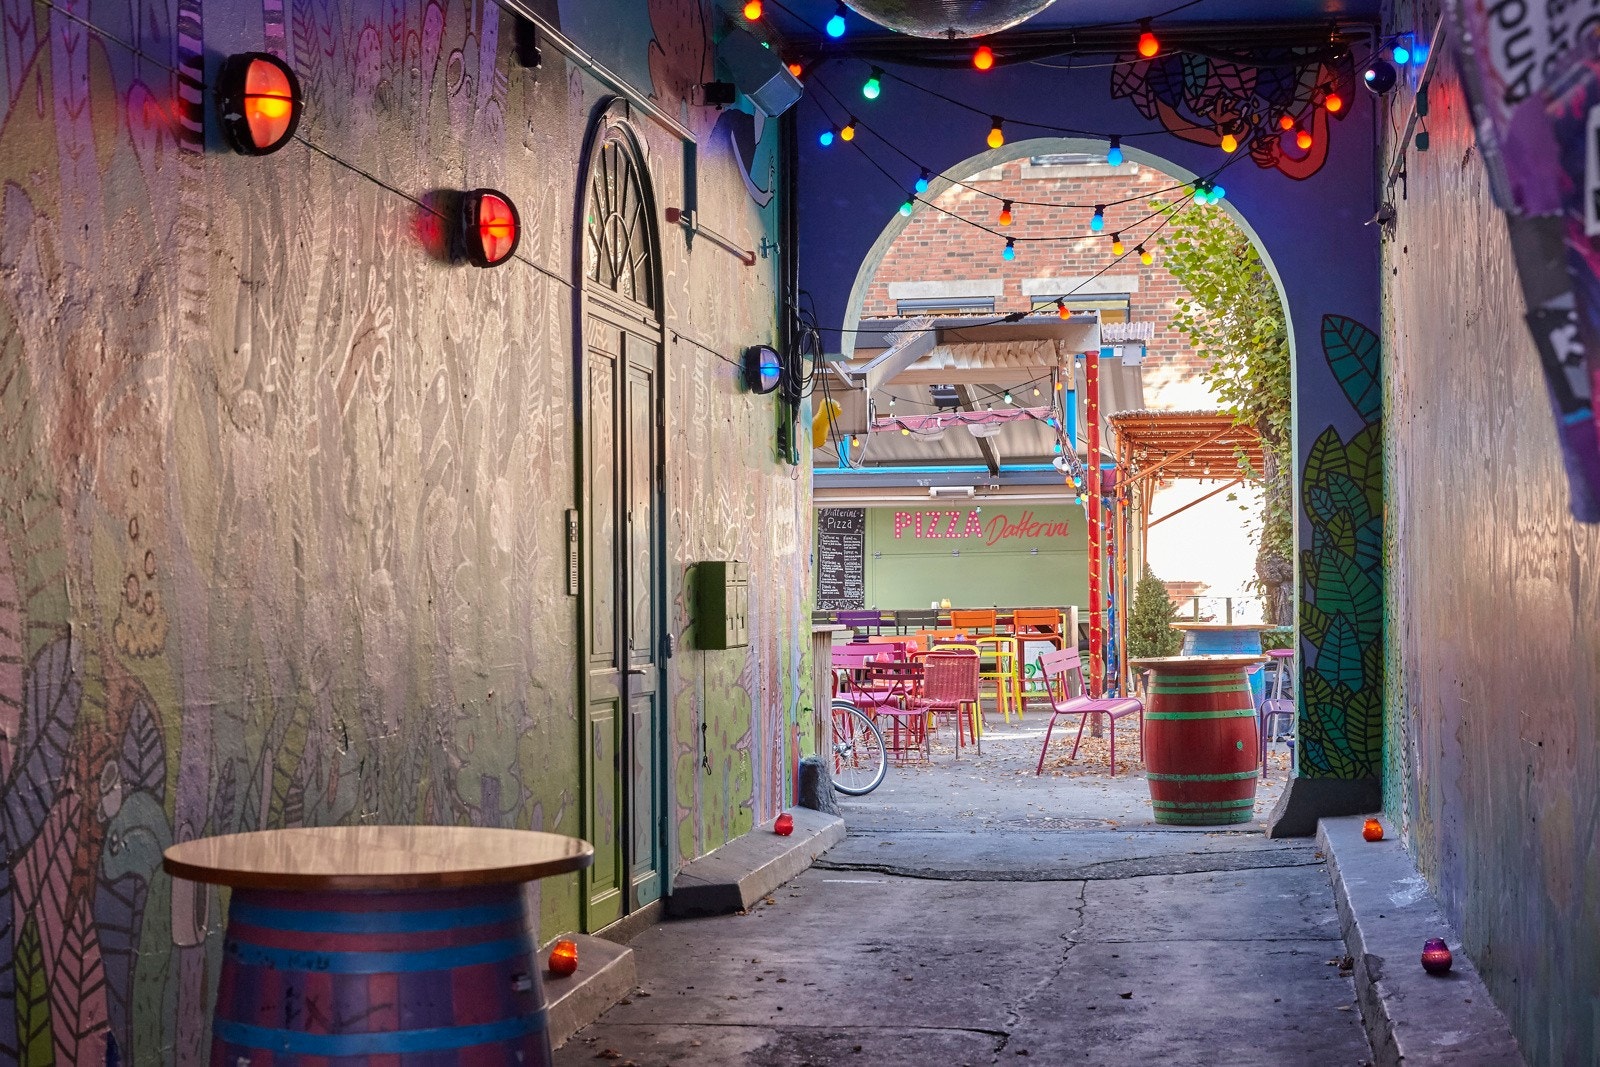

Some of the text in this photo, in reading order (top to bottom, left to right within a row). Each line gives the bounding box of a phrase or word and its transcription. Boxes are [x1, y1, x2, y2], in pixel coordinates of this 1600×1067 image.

[827, 517, 852, 529] Pizza
[894, 510, 1070, 546] PIZZA Datterini
